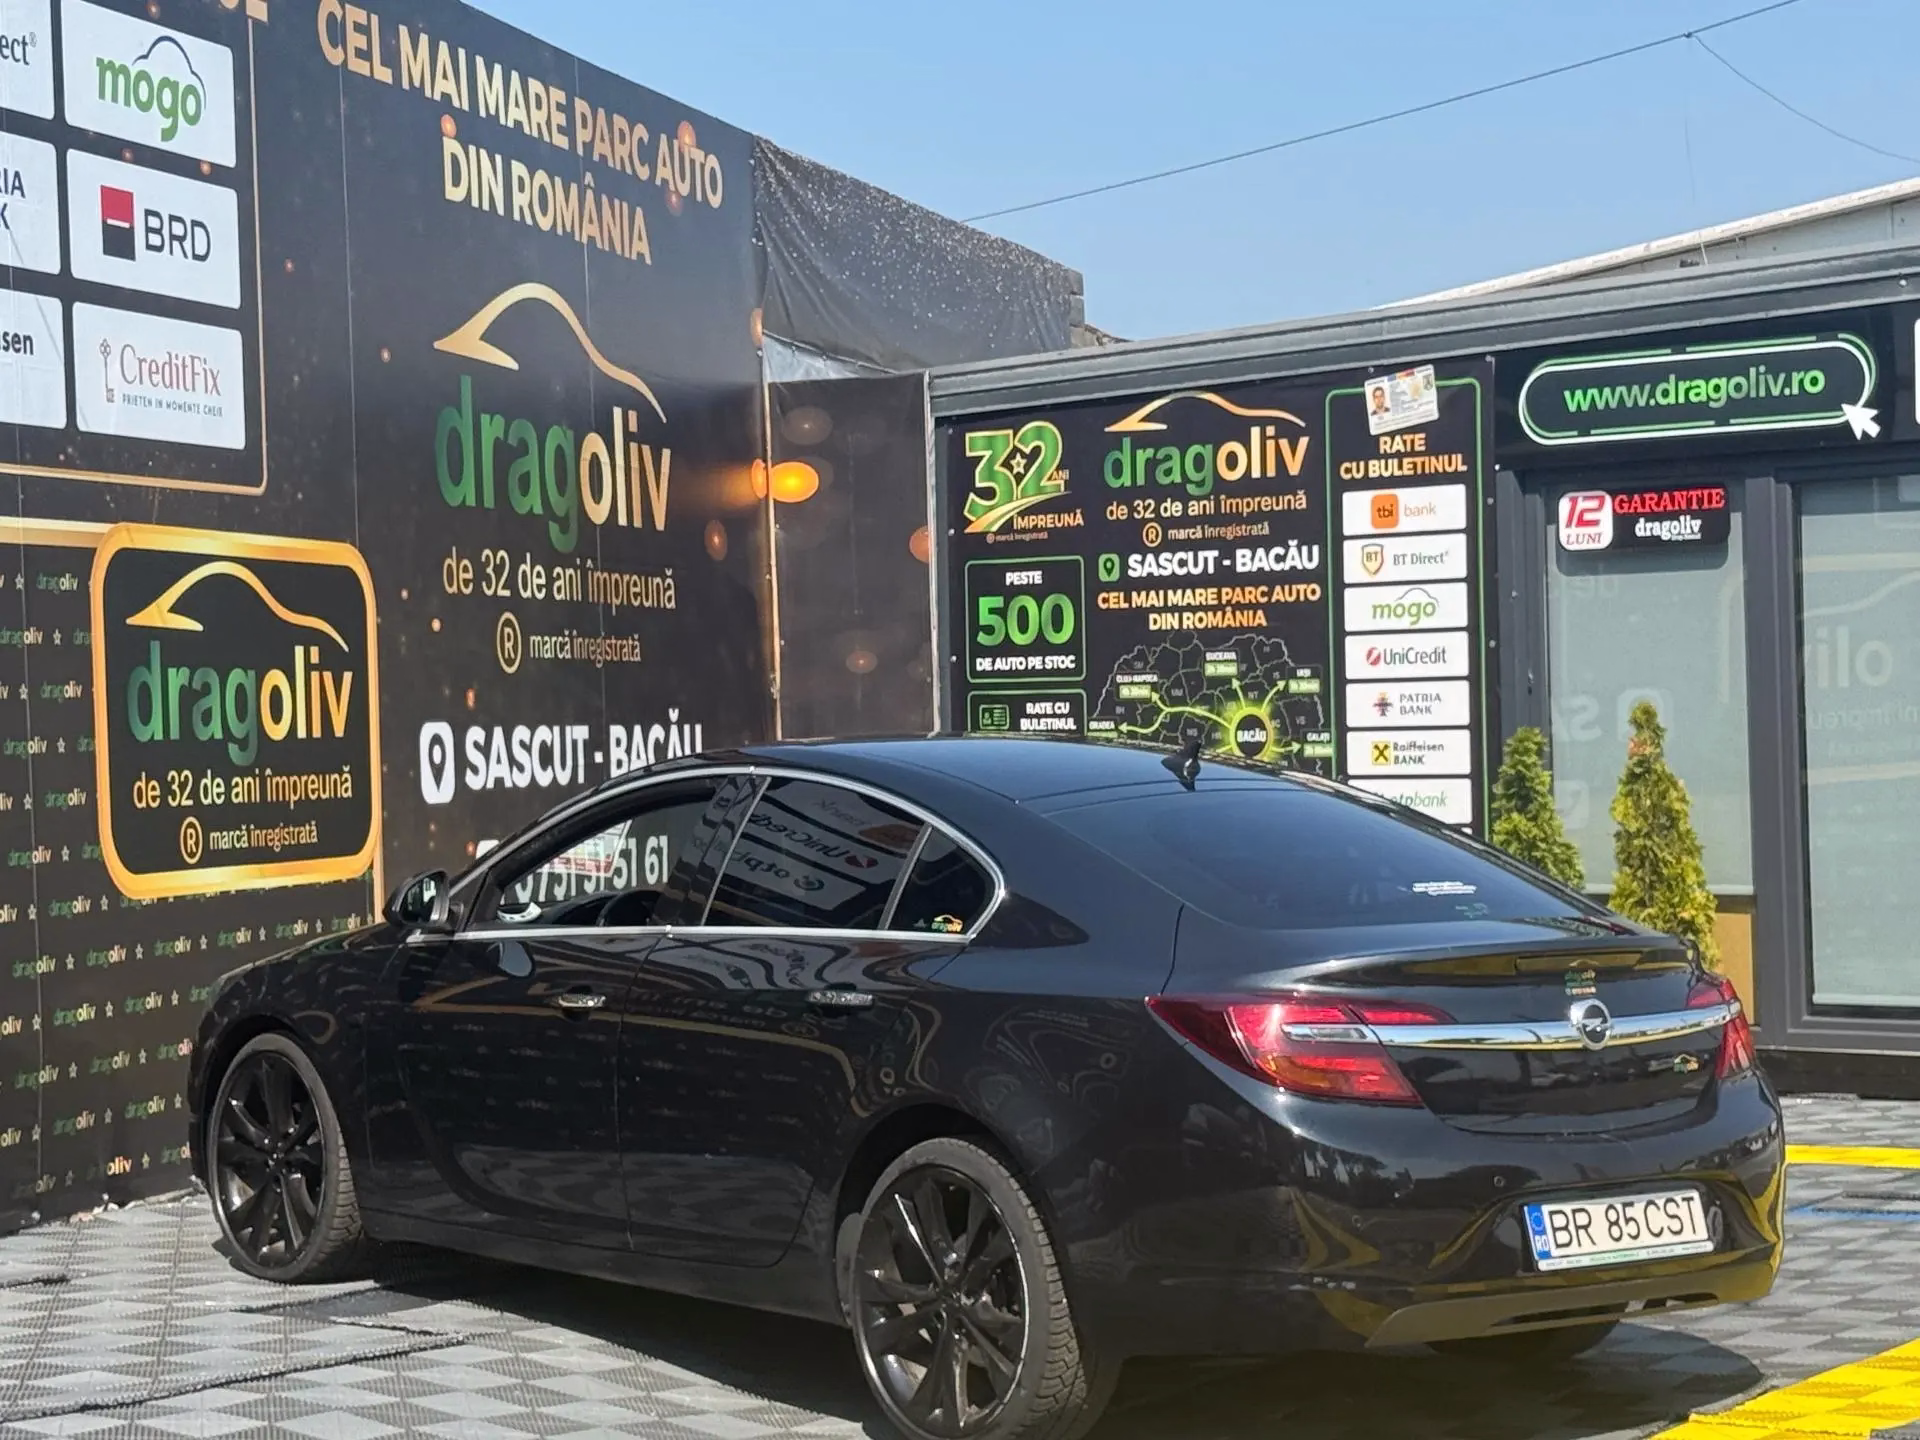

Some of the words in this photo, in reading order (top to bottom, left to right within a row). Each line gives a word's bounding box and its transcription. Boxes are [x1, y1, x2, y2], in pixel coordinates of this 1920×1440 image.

[96, 57, 203, 142] mogo
[317, 0, 393, 85] CEL
[399, 24, 468, 112] MAI
[475, 55, 569, 151] MARE
[574, 96, 650, 181] PARC
[655, 133, 723, 209] AUTO
[0, 168, 26, 199] IA
[442, 136, 505, 217] DIN
[510, 172, 652, 266] ROMÂNIA
[144, 208, 211, 262] BRD
[120, 344, 221, 397] CreditFix
[1563, 365, 1826, 413] www.dragoliv.ro
[1379, 433, 1427, 454] RATE
[435, 375, 671, 553] dragoliv
[963, 421, 1063, 521] 32
[1104, 426, 1310, 496] dragoliv
[1339, 461, 1365, 480] CU
[1368, 454, 1468, 478] BULETINUL
[1106, 501, 1128, 520] de
[1133, 499, 1155, 519] 32
[1160, 498, 1183, 517] de
[1187, 496, 1214, 515] ani
[1220, 490, 1307, 517] împreună
[1376, 503, 1394, 519] tbi
[1403, 503, 1437, 517] bank
[1565, 495, 1605, 529] 12
[1614, 488, 1725, 514] GARANTIE
[1168, 524, 1202, 541] marcă
[1204, 521, 1269, 541] înregistrată
[1566, 532, 1603, 546] LUNI
[1635, 515, 1702, 541] dragoliv
[1127, 550, 1219, 578] SASCUT
[1236, 539, 1319, 573] BACĂU
[1365, 551, 1379, 563] BT
[1393, 553, 1408, 566] BT
[443, 546, 473, 595] de
[481, 549, 511, 597] 32
[517, 553, 546, 600] de
[553, 558, 582, 601] ani
[587, 558, 676, 616] împreună
[1005, 571, 1043, 586] PESTE
[1097, 592, 1129, 609] CEL
[1132, 590, 1164, 608] MAI
[1168, 588, 1218, 607] MARE
[1221, 586, 1268, 605] PARC
[1271, 583, 1321, 602] AUTO
[976, 593, 1075, 646] 500
[1149, 612, 1182, 631] DIN
[1182, 607, 1267, 630] ROMÂNIA
[1372, 602, 1436, 626] mogo
[529, 629, 571, 661] marcă
[572, 629, 641, 668] înregistrată
[1383, 646, 1447, 666] UniCredit
[976, 658, 993, 671] DE
[994, 656, 1026, 670] AUTO
[1028, 656, 1043, 669] PE
[1044, 655, 1076, 669] STOC
[127, 640, 353, 766] dragoliv
[1026, 702, 1053, 715] RATE
[1054, 701, 1070, 714] CU
[1400, 693, 1442, 704] PATRIA
[1400, 705, 1432, 716] BANK
[1020, 717, 1077, 731] BULETINUL
[465, 724, 589, 791] SASCUT
[1393, 741, 1444, 752] Raiffeisen
[1393, 754, 1424, 765] BANK
[133, 772, 161, 808] de
[167, 770, 193, 807] 32
[200, 769, 225, 805] de
[231, 768, 260, 803] ani
[265, 766, 353, 809] împreună
[209, 824, 249, 850] marcă
[250, 820, 318, 852] înregistrată
[644, 835, 668, 885] 61
[1534, 1234, 1549, 1251] RO
[1548, 1208, 1596, 1249] BR
